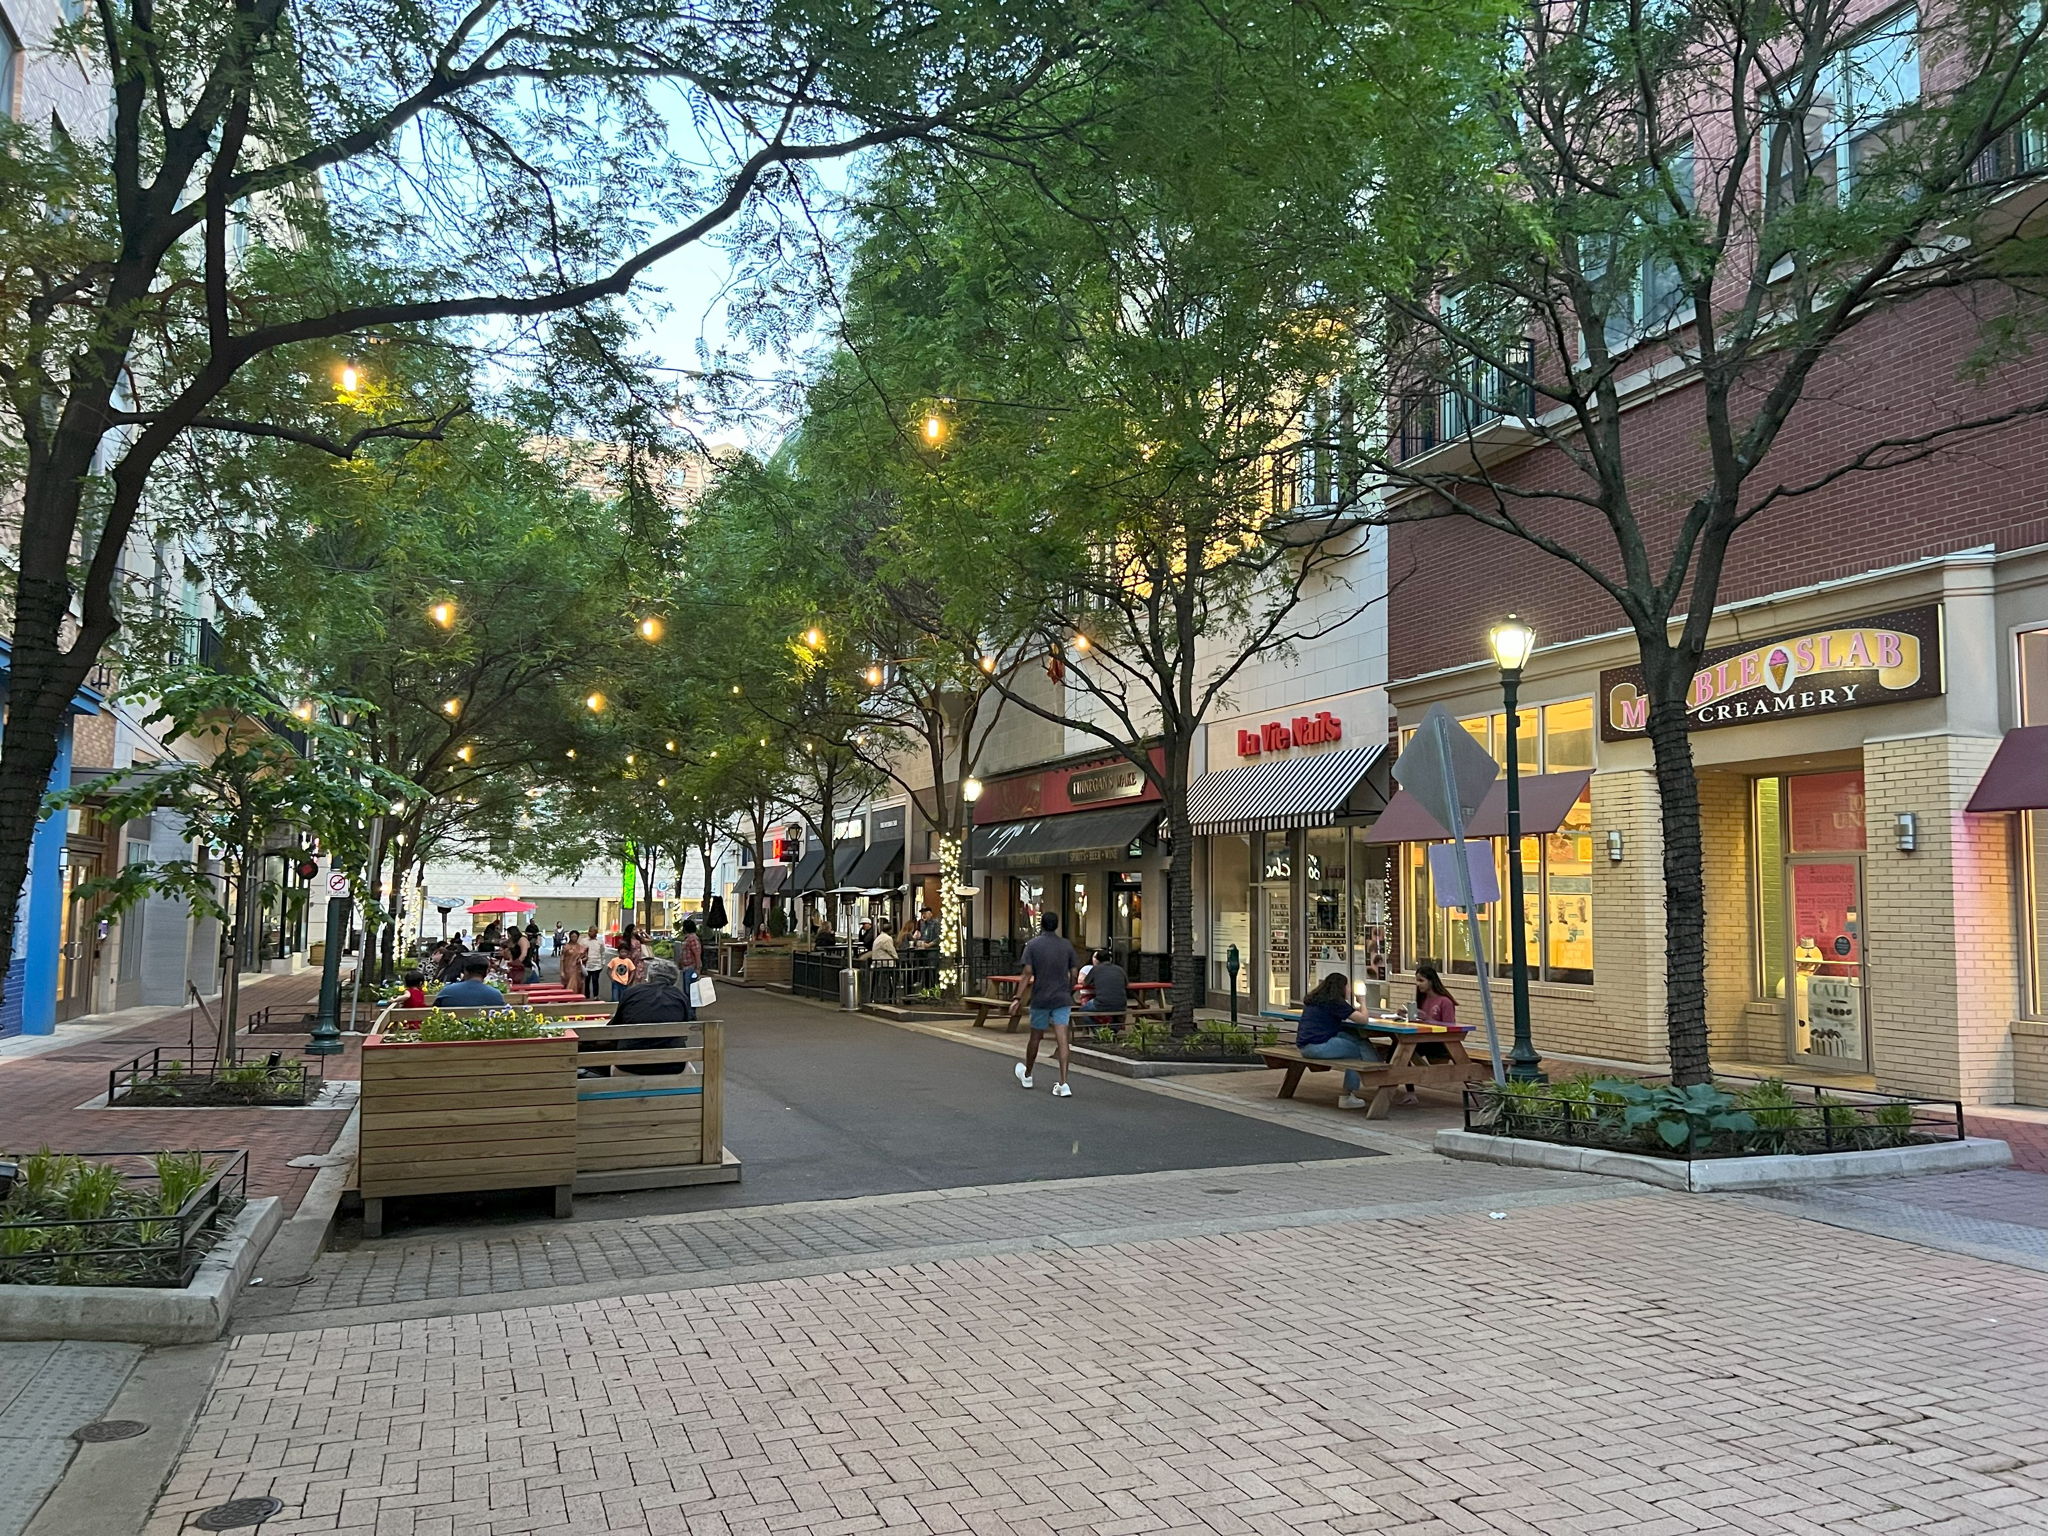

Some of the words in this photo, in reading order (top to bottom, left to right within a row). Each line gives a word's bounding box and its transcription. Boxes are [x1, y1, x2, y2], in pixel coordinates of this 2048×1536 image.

[1620, 654, 1761, 729] MBLE
[1794, 632, 1904, 672] SLAB
[1697, 684, 1860, 723] CREAMERY
[1260, 722, 1291, 751] Vie
[1291, 711, 1342, 747] Nails
